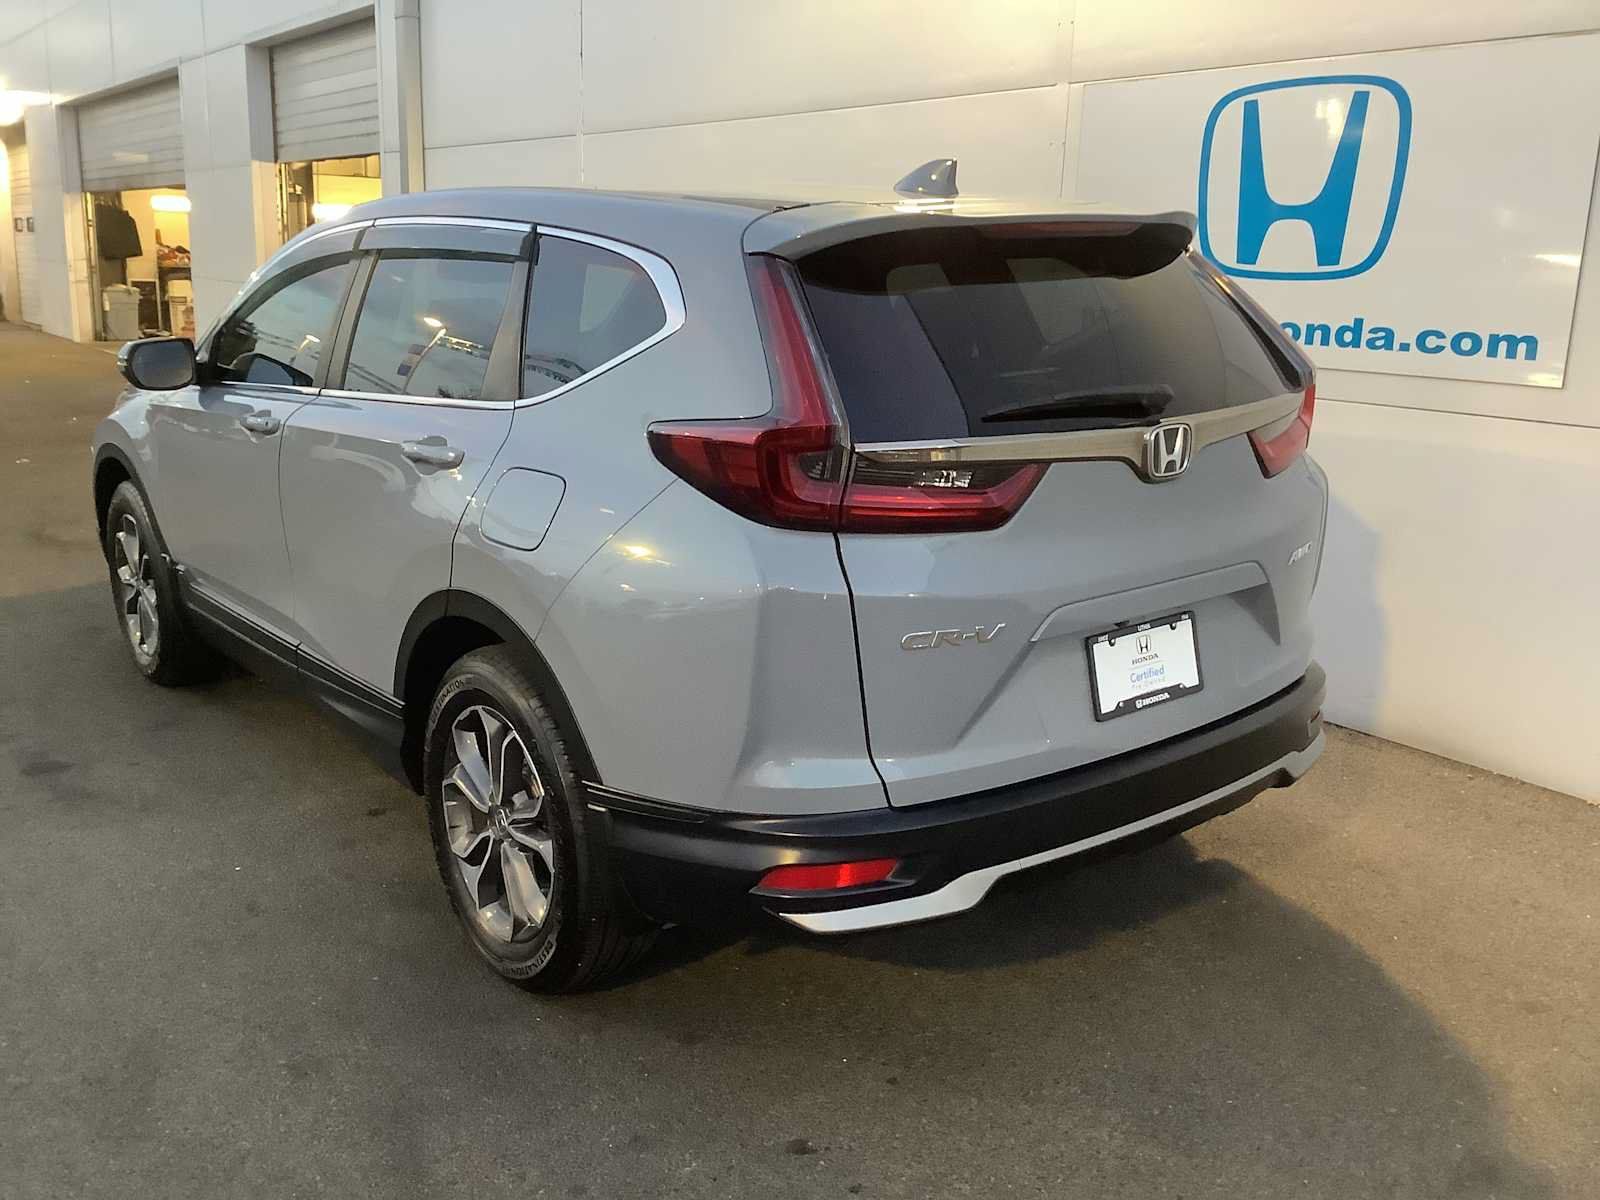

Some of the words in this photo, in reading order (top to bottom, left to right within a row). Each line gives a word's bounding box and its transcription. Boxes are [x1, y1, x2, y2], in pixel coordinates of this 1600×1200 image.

[1279, 317, 1539, 361] onda.com
[901, 623, 1006, 650] CR-V
[1131, 653, 1159, 665] HONDA
[1130, 664, 1165, 683] Certified
